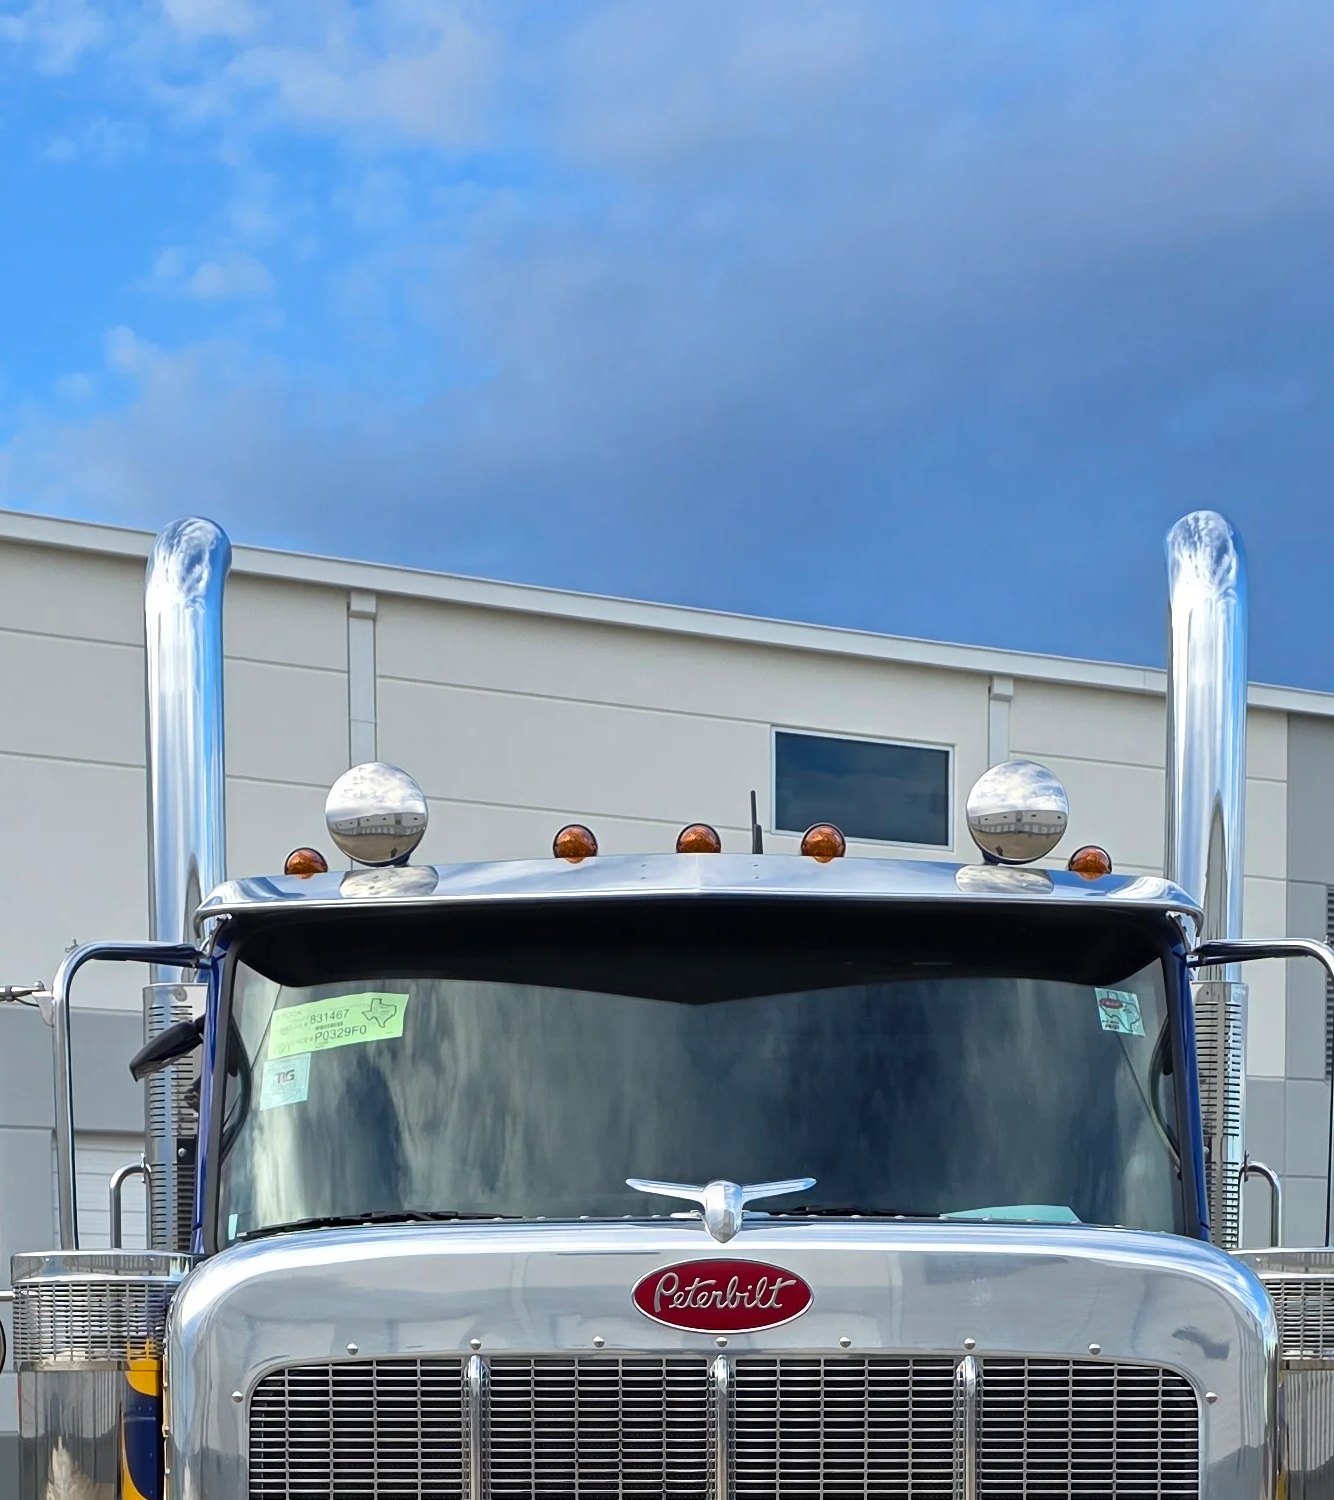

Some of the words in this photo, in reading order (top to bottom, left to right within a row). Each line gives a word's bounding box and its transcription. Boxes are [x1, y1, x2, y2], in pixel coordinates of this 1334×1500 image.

[310, 1009, 350, 1025] 831467
[314, 1025, 367, 1042] P0329F0
[653, 1272, 797, 1313] Peterbilt
